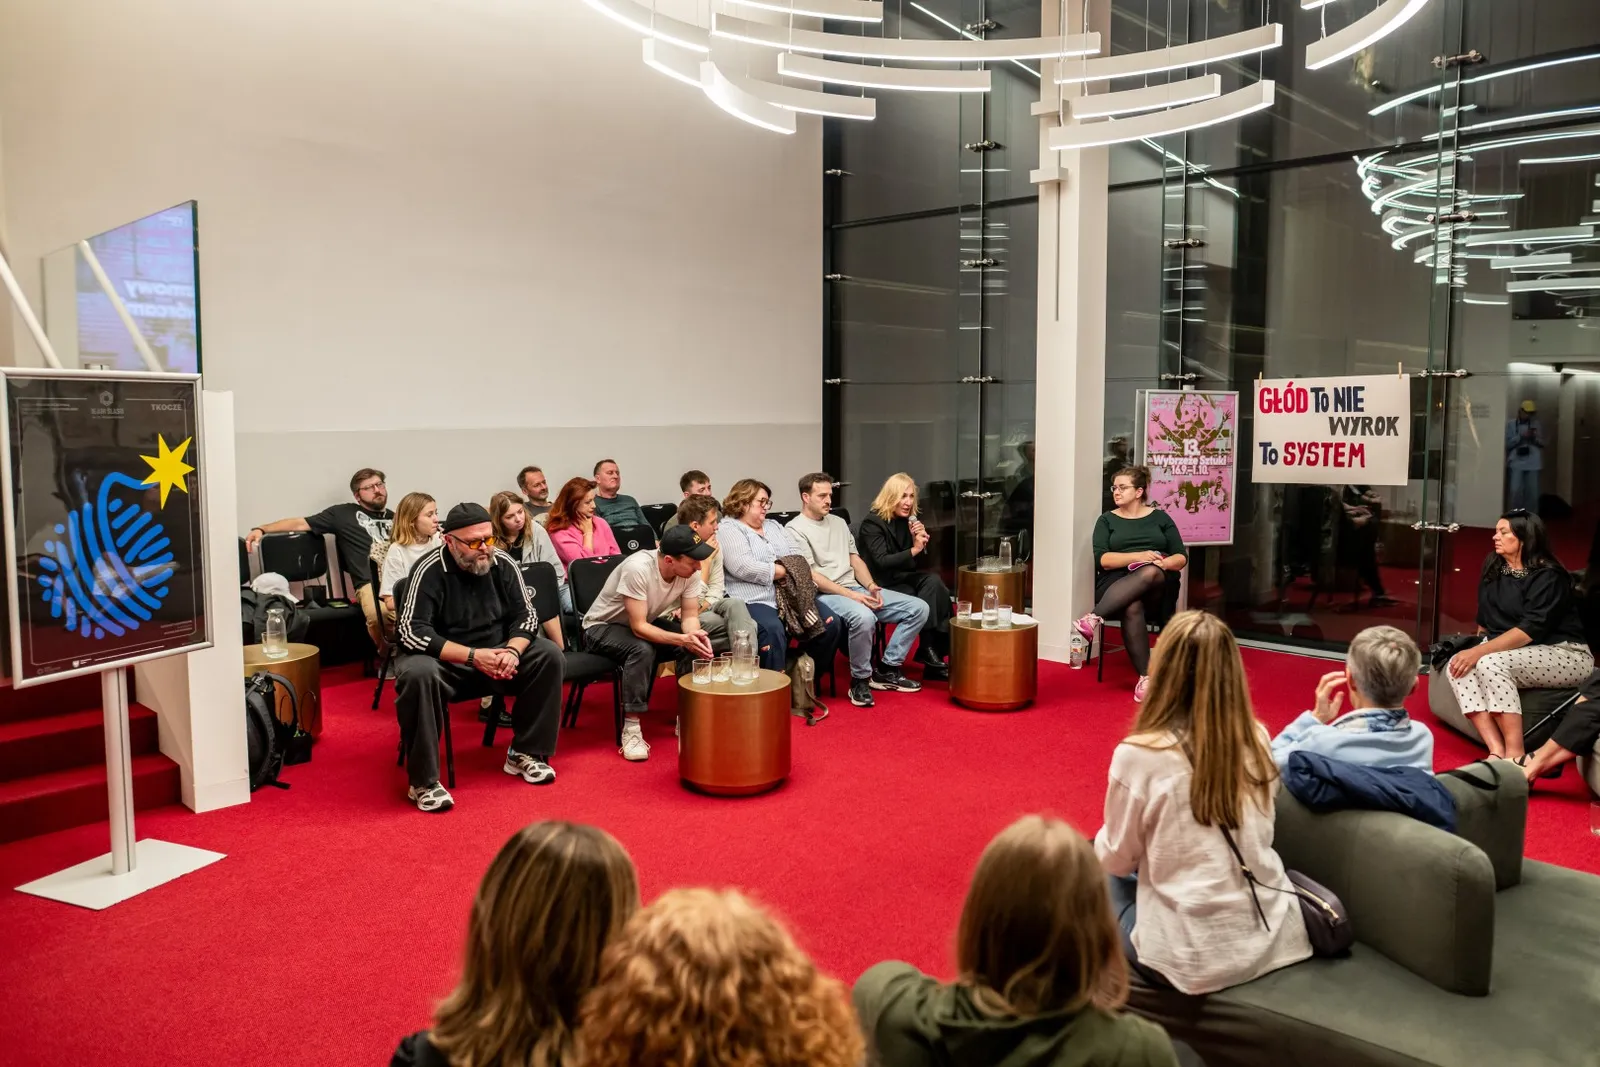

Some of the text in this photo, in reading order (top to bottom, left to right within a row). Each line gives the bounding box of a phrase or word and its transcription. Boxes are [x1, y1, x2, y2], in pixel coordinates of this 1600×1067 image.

[1259, 381, 1308, 414] GŁÓD
[1334, 386, 1365, 412] NIE
[1329, 416, 1399, 437] WYROK
[1182, 438, 1201, 456] 13.
[1283, 442, 1365, 468] SYSTEM
[1153, 455, 1227, 467] Wybrzeże Sztuki
